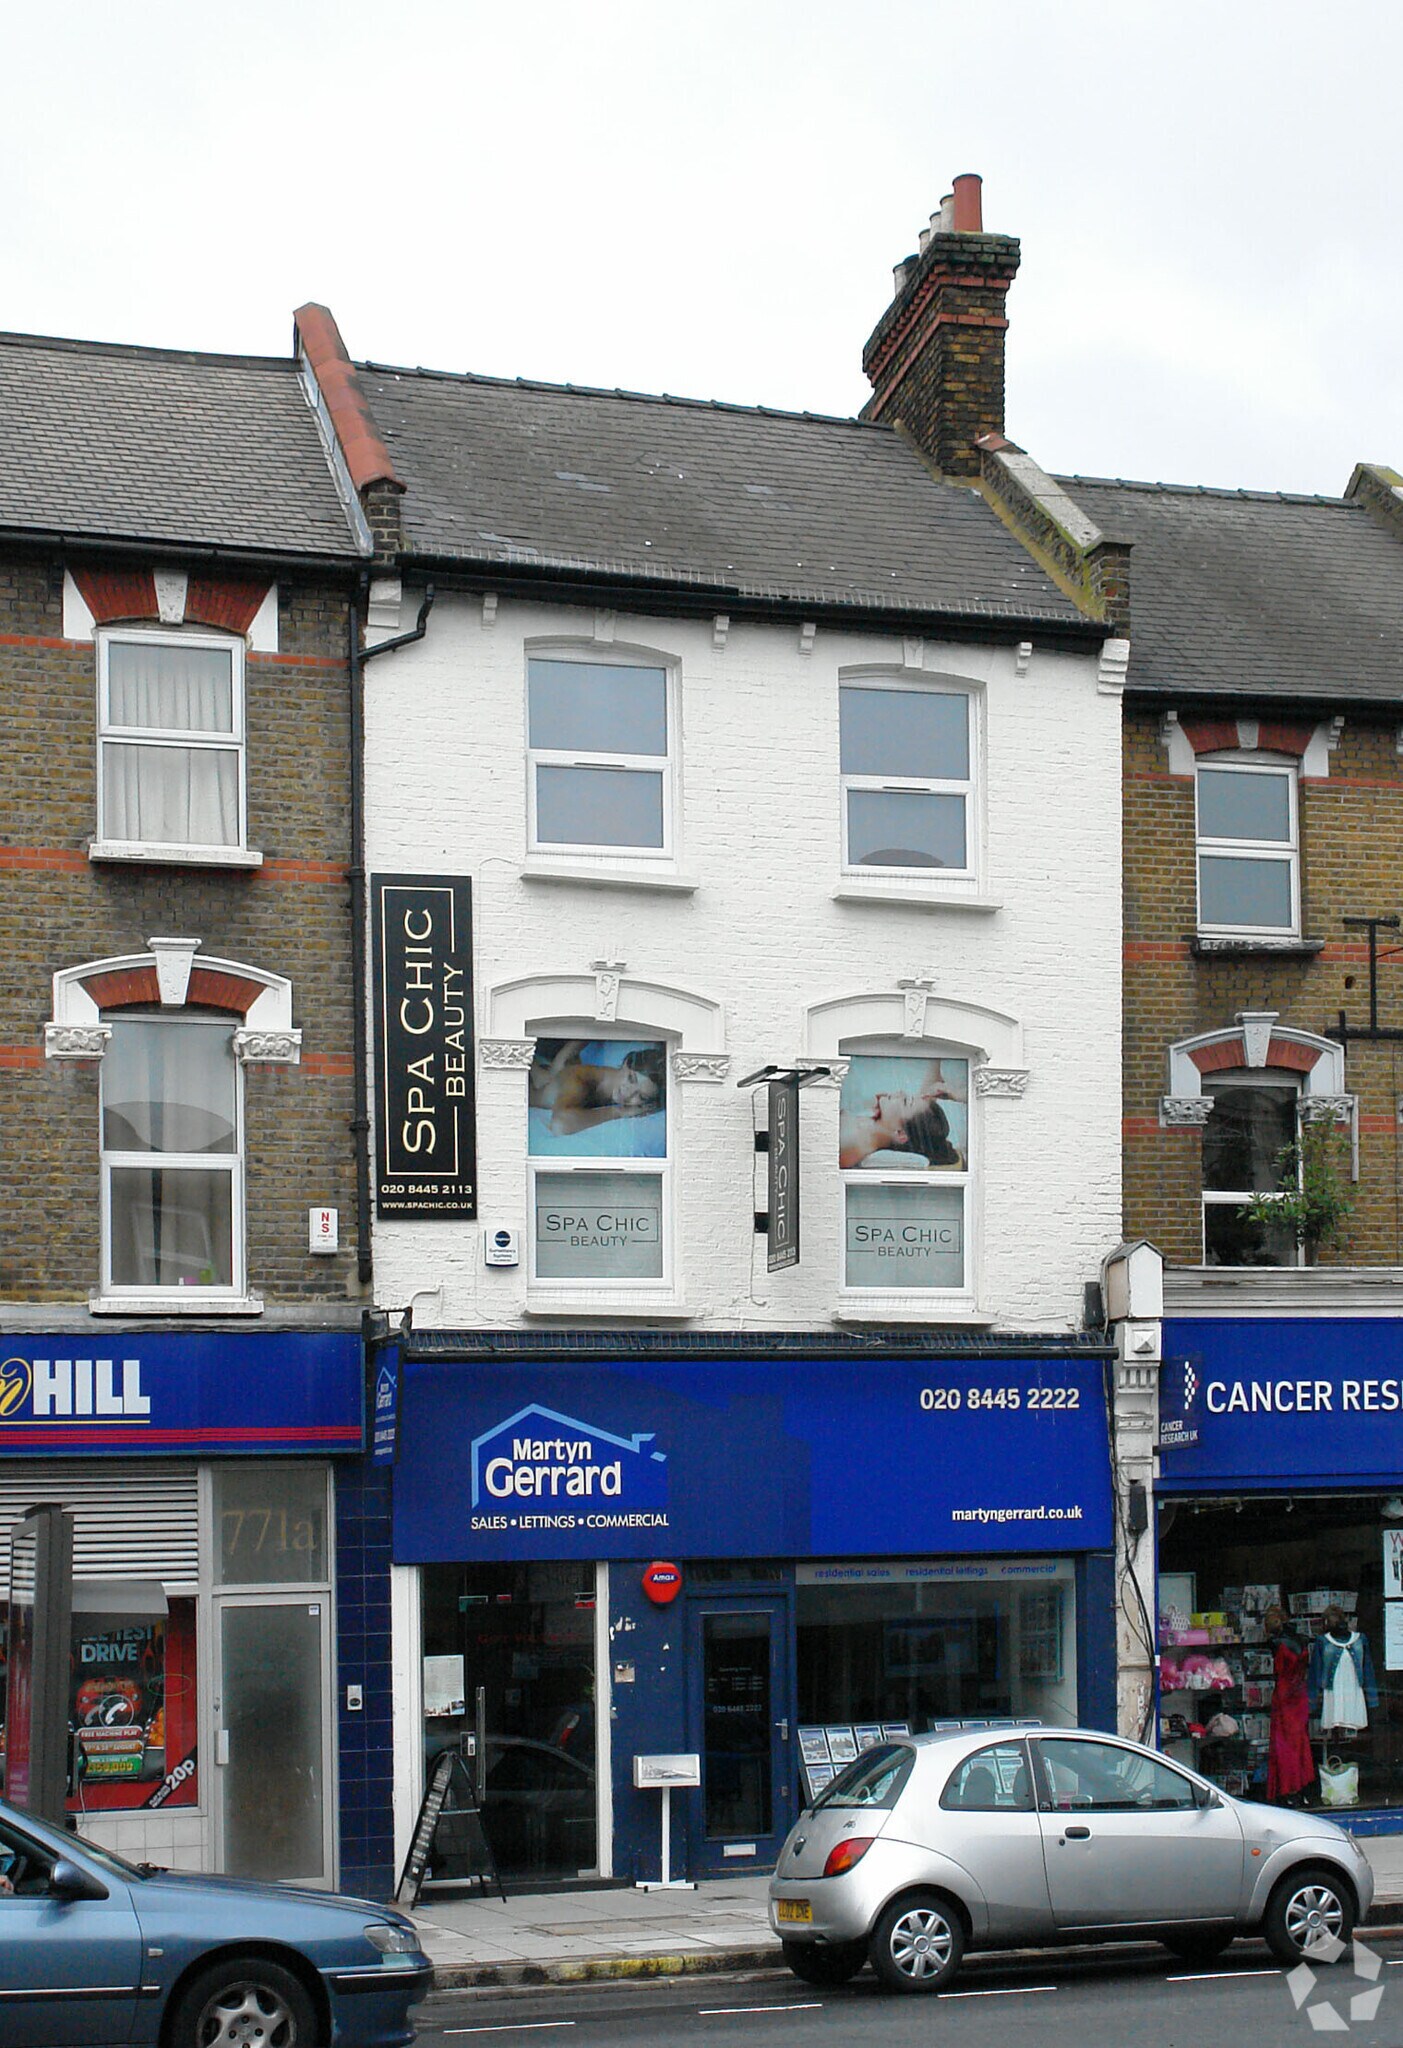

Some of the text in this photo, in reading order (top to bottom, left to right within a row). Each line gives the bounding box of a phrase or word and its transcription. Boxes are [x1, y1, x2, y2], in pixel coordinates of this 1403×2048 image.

[400, 908, 436, 1155] SPA CHIC
[443, 962, 465, 1097] BEAUTY
[777, 1097, 788, 1240] SPA CHIC
[381, 1184, 472, 1194] 020 8445 2113
[381, 1201, 473, 1209] WWW.SPACHIC.CO.UK
[321, 1211, 330, 1222] N
[546, 1214, 649, 1231] SPA CHIC
[321, 1223, 330, 1233] S
[855, 1225, 952, 1243] SPA CHIC
[570, 1235, 627, 1246] BEAUTY
[878, 1246, 931, 1257] BEAUTY
[33, 1360, 150, 1415] HILL
[919, 1388, 1080, 1410] 020 8445 2222
[1207, 1382, 1332, 1412] CANCER
[1161, 1420, 1184, 1433] CANCER
[1161, 1430, 1198, 1444] RESEARCH UK
[513, 1438, 592, 1464] Martyn
[485, 1458, 622, 1497] Gerrard
[471, 1513, 670, 1530] SALES LETTINGS COMMERCIAL
[951, 1505, 1083, 1524] martyngerrard.co.uk
[223, 1507, 317, 1556] 771a
[815, 1564, 1057, 1579] residential sales residential lettings commercial
[81, 1643, 138, 1662] DRIVE
[166, 1759, 195, 1790] 20p
